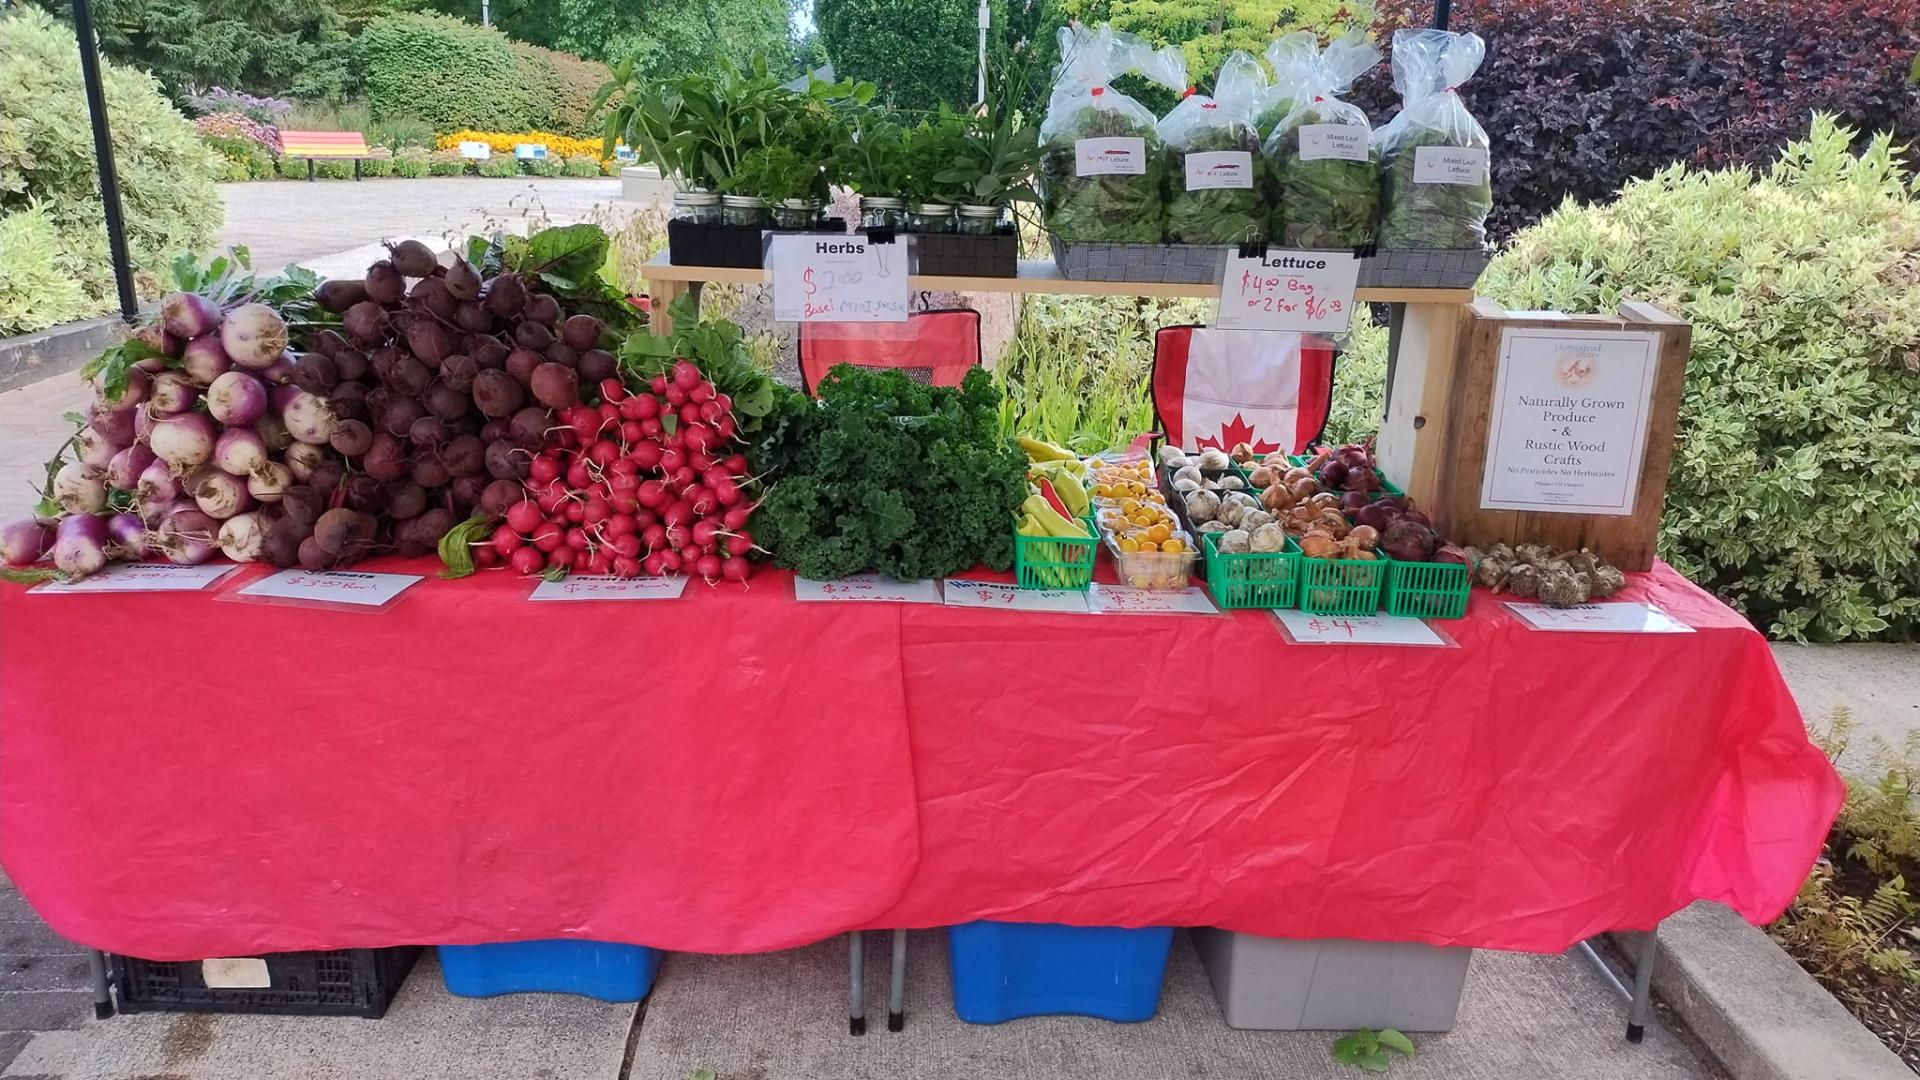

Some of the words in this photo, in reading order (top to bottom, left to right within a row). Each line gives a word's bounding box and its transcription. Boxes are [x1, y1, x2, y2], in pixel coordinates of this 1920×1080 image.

[816, 242, 865, 254] Herbs
[1262, 257, 1326, 270] Lettuce
[1288, 279, 1313, 295] Bag
[1248, 299, 1261, 308] or
[1264, 297, 1273, 312] 2
[1278, 299, 1298, 312] for
[1518, 396, 1578, 410] Naturally
[1581, 397, 1625, 409] Grown
[1543, 411, 1596, 423] Produce
[1561, 426, 1572, 437] &
[1525, 439, 1564, 451] Rustic
[1568, 441, 1605, 452] Wood
[1544, 454, 1582, 466] Crafts
[1507, 466, 1519, 474] No
[1521, 467, 1558, 475] Pesticides
[1574, 469, 1615, 477] Herbicides
